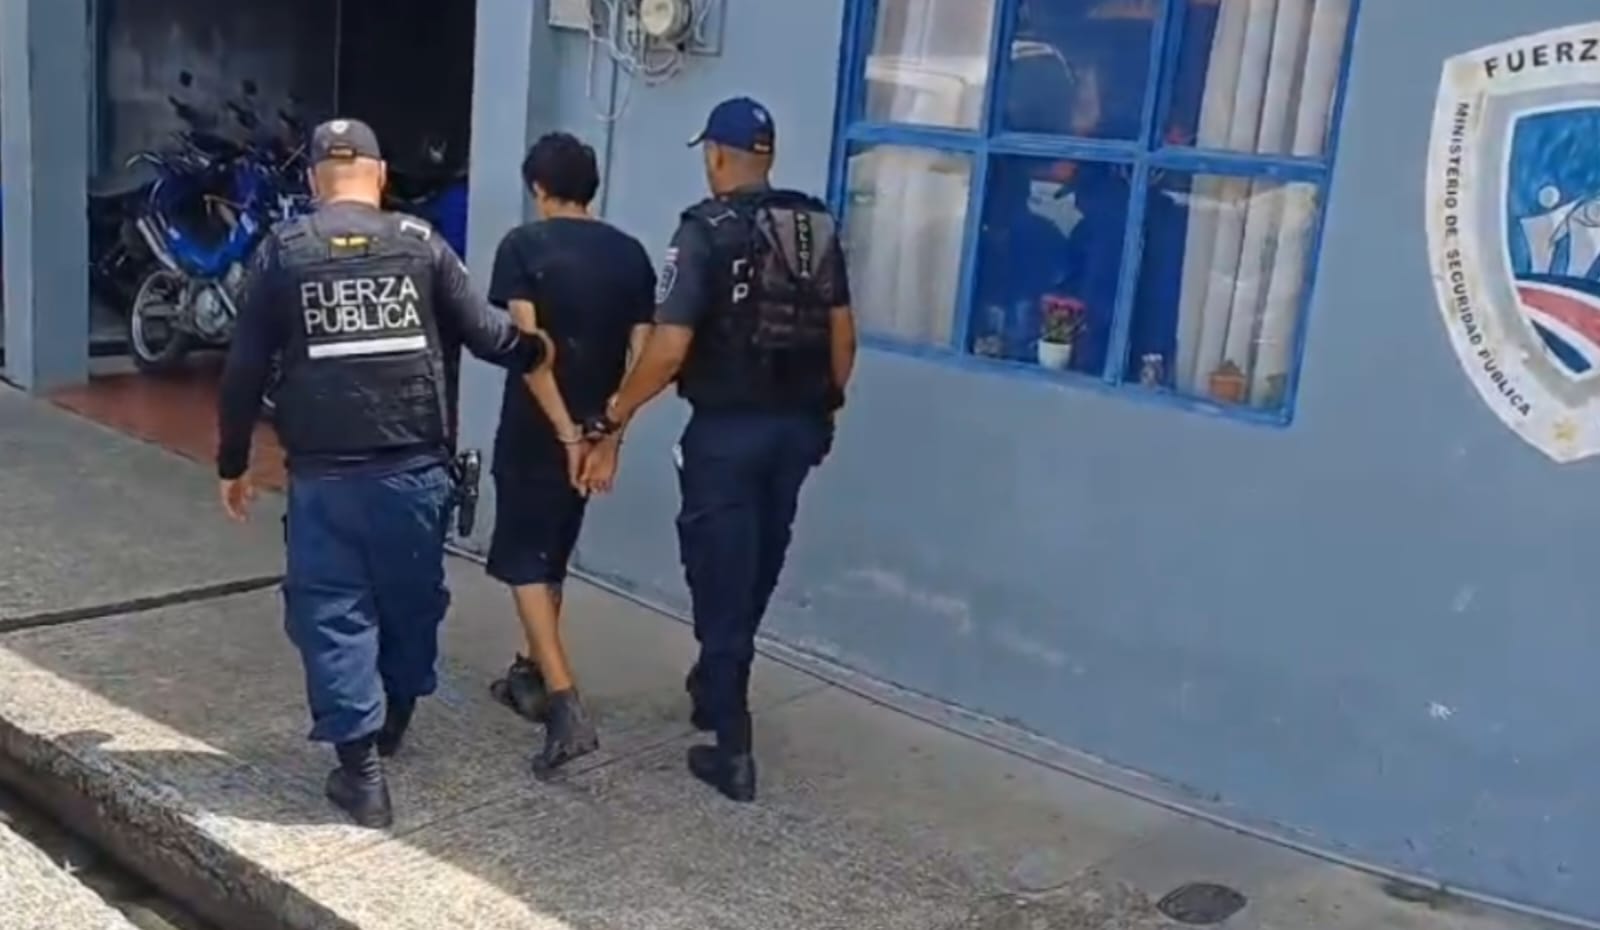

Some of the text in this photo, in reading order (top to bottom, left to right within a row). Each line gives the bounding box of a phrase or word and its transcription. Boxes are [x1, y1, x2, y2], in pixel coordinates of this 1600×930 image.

[1484, 39, 1599, 78] FUERZ
[1444, 102, 1532, 417] MINISTERIO DE SEGURIDAD PUBLICA
[301, 275, 419, 307] FUERZA
[304, 301, 421, 334] PUBLICA
